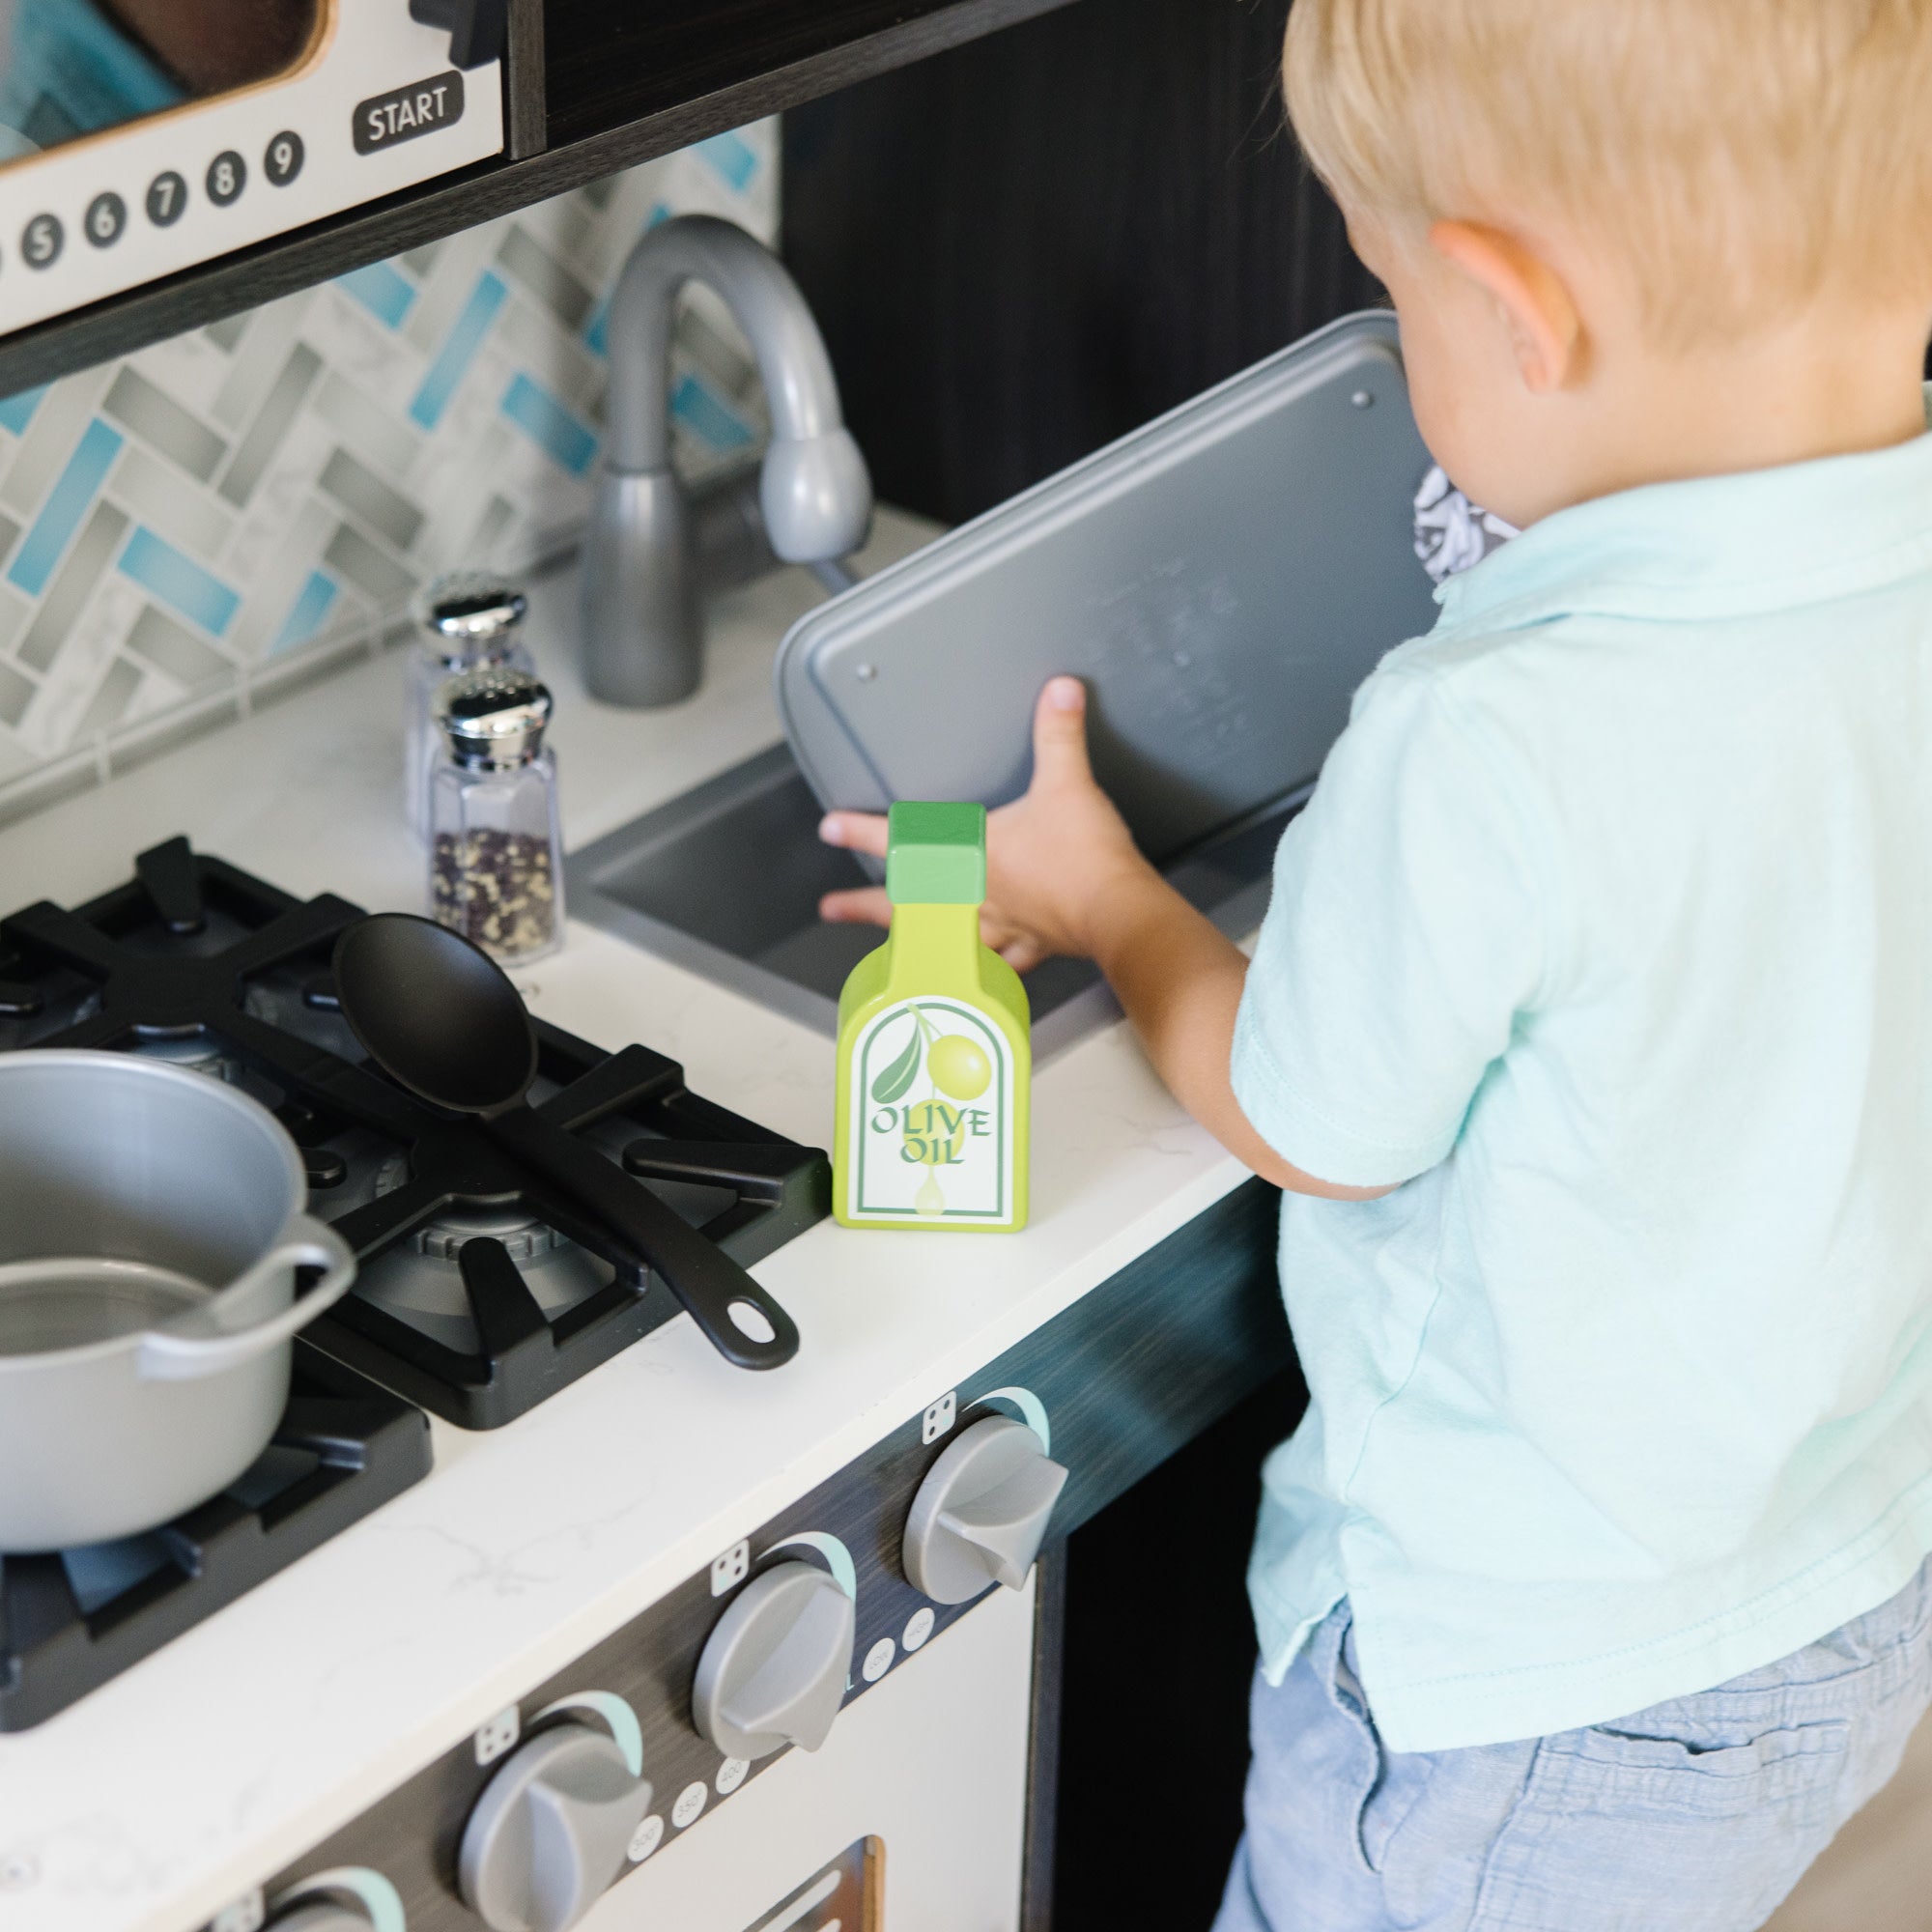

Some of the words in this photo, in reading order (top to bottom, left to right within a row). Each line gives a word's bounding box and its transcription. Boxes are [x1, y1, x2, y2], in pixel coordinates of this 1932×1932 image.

[368, 86, 448, 141] START
[32, 221, 54, 262] 5
[95, 202, 117, 239] 6
[155, 180, 176, 218] 7
[214, 161, 236, 196] 8
[273, 142, 293, 176] 9
[871, 1104, 992, 1136] OLIVE
[900, 1137, 965, 1165] OIL
